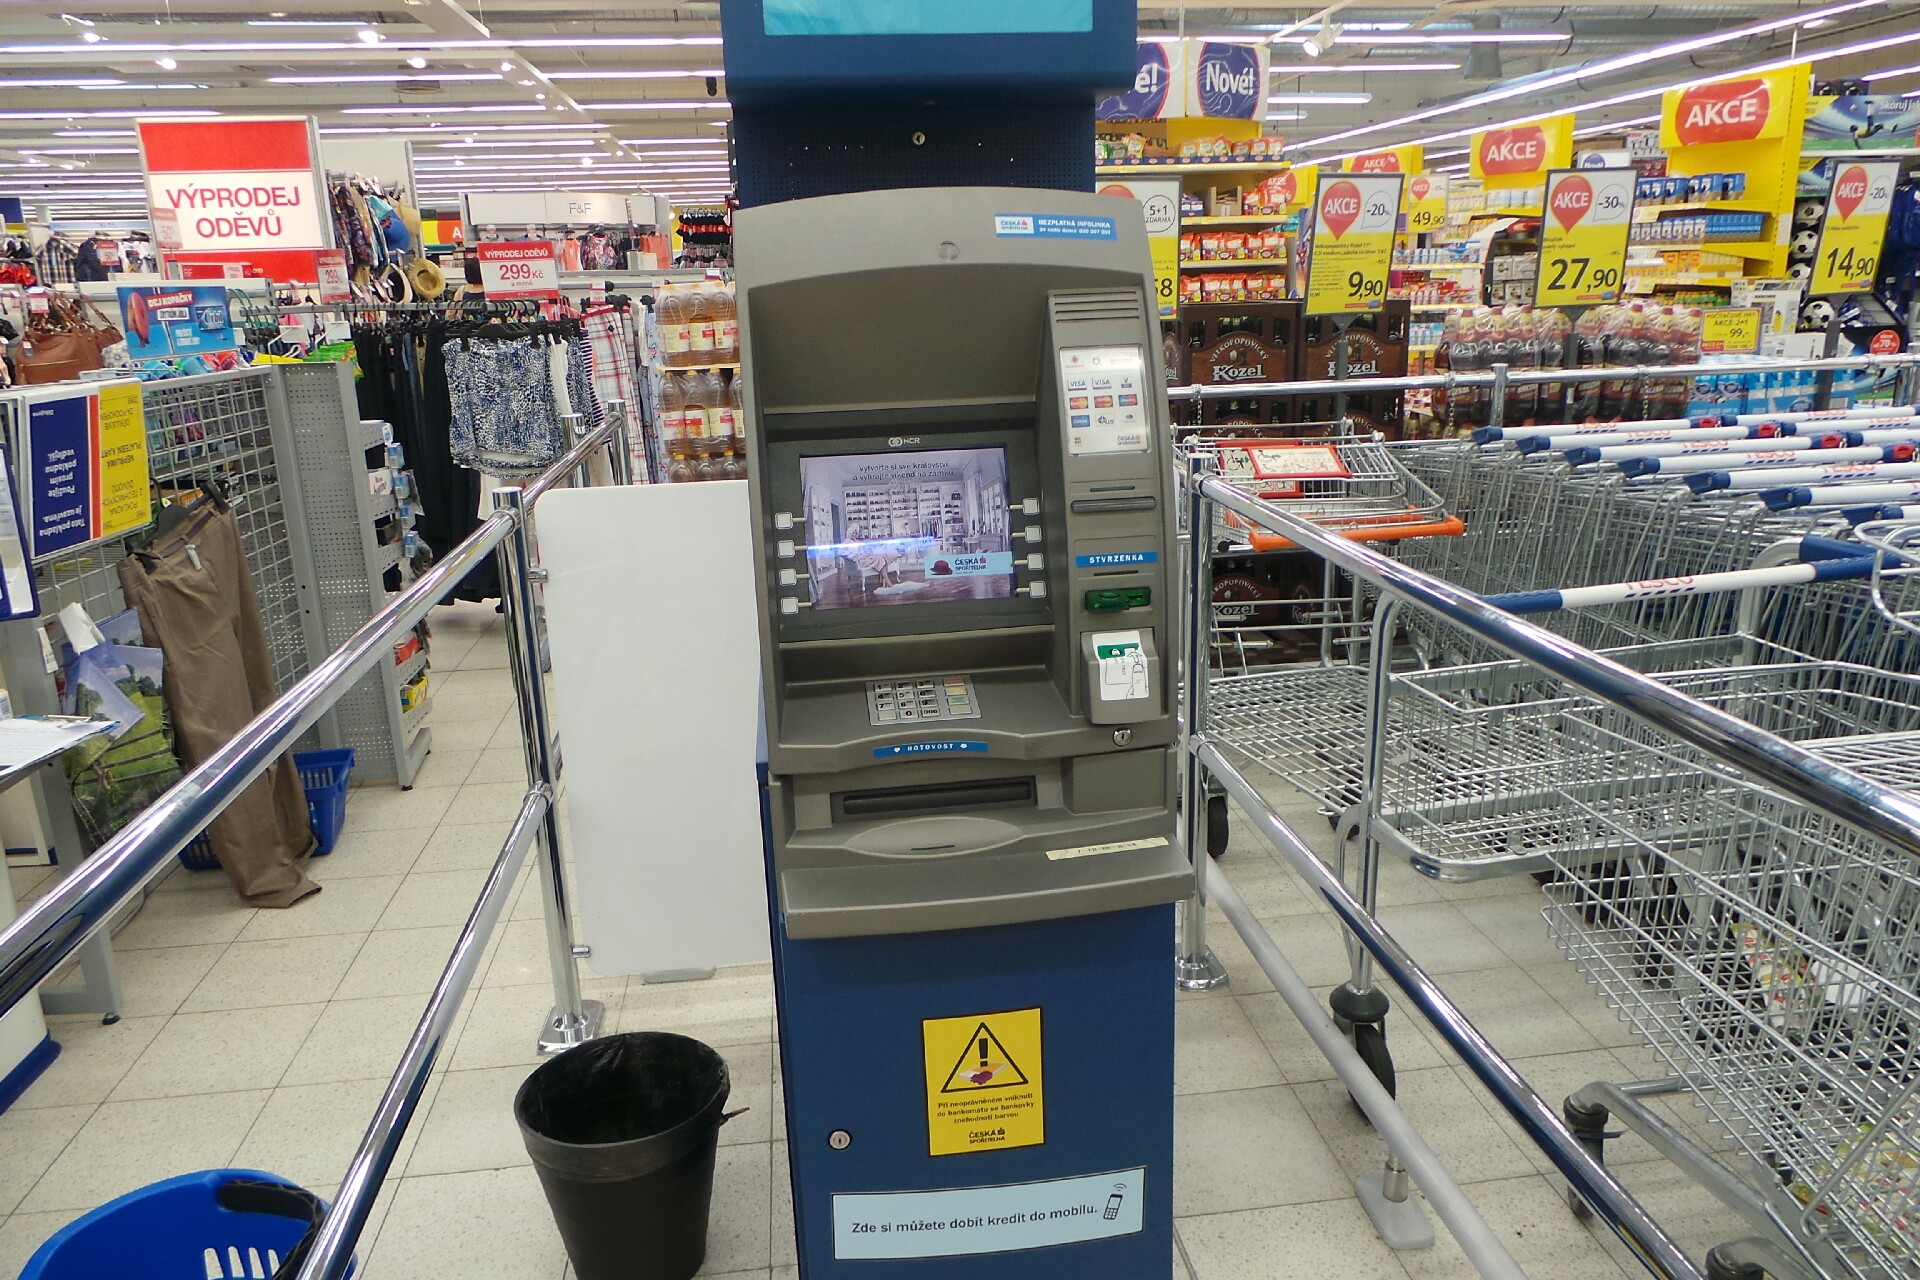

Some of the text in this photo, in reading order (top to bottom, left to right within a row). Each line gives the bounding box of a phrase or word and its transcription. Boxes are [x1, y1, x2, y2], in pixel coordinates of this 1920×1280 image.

[1206, 63, 1254, 96] Nové!
[1685, 98, 1757, 128] AKCE
[1485, 141, 1537, 163] AKCE
[1364, 158, 1386, 168] AKCE
[1413, 183, 1428, 191] AKCE
[1837, 182, 1865, 198] AKCE
[166, 183, 300, 208] VÝPRODEJ
[1554, 192, 1589, 209] AKCE
[569, 202, 592, 214] F&F
[1149, 205, 1168, 216] 5+1
[1325, 198, 1357, 215] AKCE
[196, 209, 282, 238] ODĚVŮ
[1412, 212, 1445, 226] 49,90
[485, 247, 548, 259] VÝPRODEJ ODĚVŮ
[1827, 246, 1874, 280] 14,90
[500, 263, 544, 280] 299 Kč
[1547, 257, 1618, 292] 27,90
[1348, 271, 1383, 300] 9,90
[1209, 338, 1270, 363] VELKOPOPOVICKÝ
[1213, 365, 1267, 381] Kozel
[48, 448, 75, 463] vedlejší.
[45, 460, 77, 474] pokladnu
[50, 475, 73, 485] prosím
[48, 484, 75, 497] Použijte
[43, 504, 83, 522] je uzavřena.
[40, 518, 85, 537] Tato pokladna
[954, 556, 979, 566] ČESKÁ
[1089, 554, 1144, 564] STVRZENKA
[955, 563, 987, 571] SPOŘITELNA
[907, 744, 954, 752] HOTOVOST
[950, 1097, 1002, 1107] neoprávněném
[1005, 1093, 1033, 1101] vniknutí
[948, 1107, 988, 1116] bankomatu
[1001, 1101, 1034, 1110] bankovky
[954, 1115, 992, 1123] znehodnotí
[969, 1129, 996, 1138] ČESKÁ
[969, 1136, 1005, 1144] SPOŘITELNA
[852, 1204, 1098, 1234] Zde si můžete dobít kredit do mobilu.
